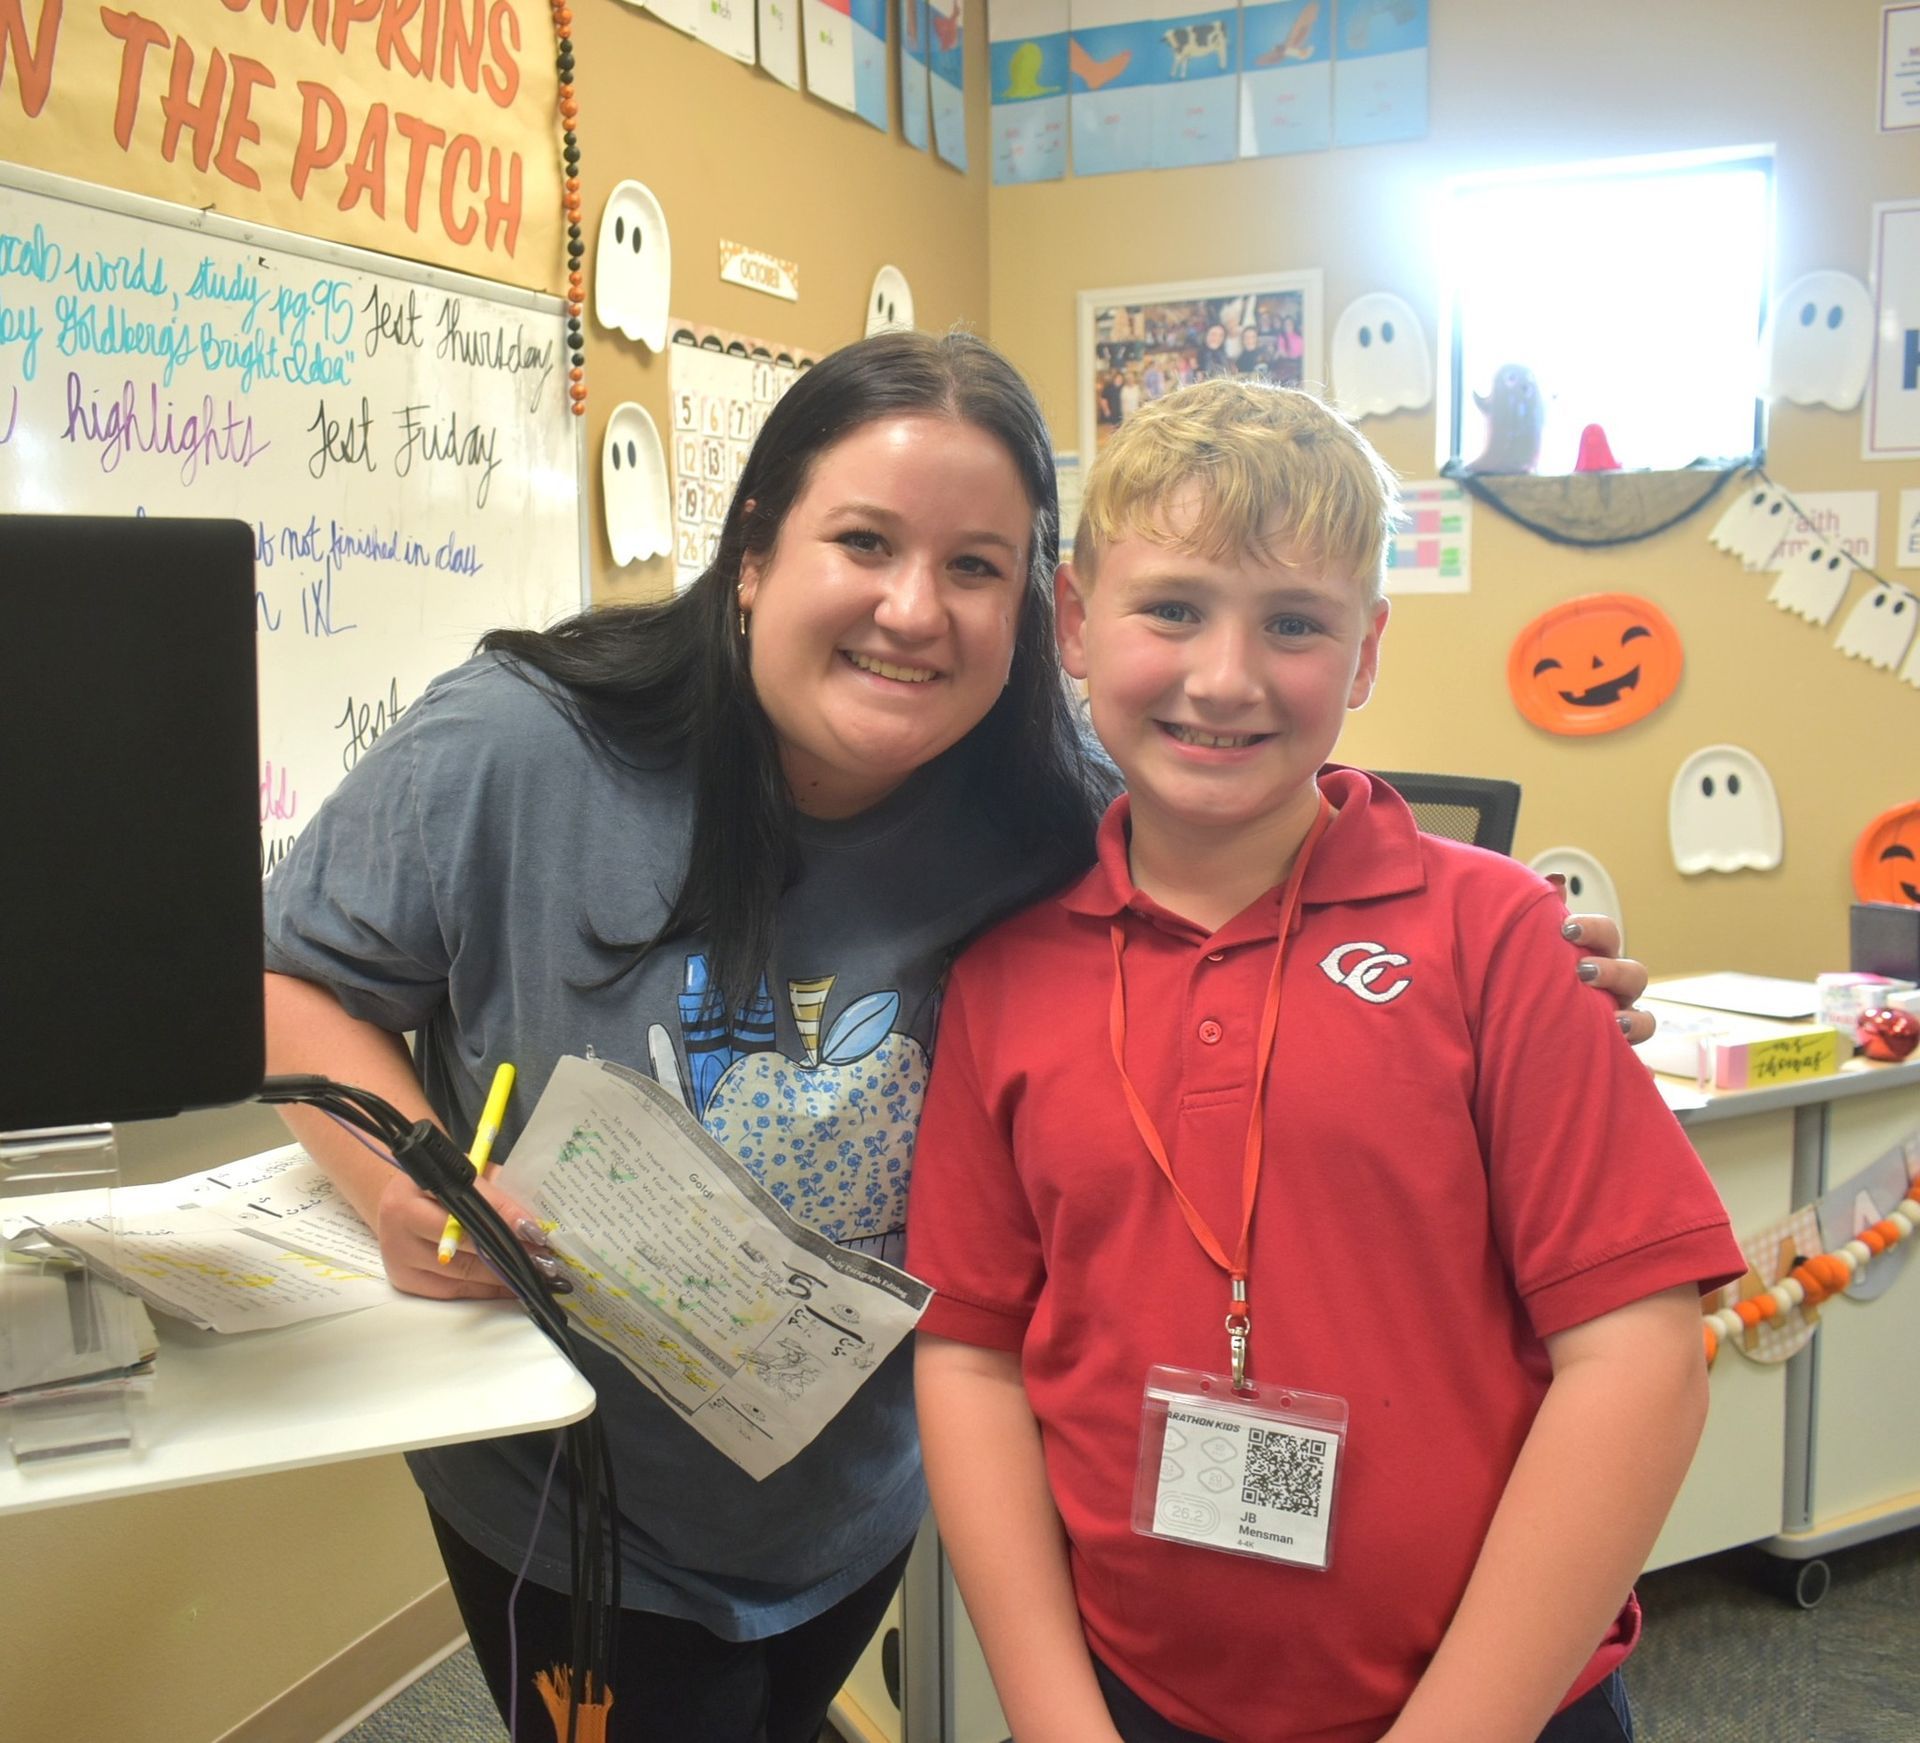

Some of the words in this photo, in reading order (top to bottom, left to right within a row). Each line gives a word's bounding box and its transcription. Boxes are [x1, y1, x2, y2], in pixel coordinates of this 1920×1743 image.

[218, 0, 521, 108] PKINS
[100, 10, 275, 191] THE
[290, 80, 523, 258] PATCH
[186, 256, 270, 333] study
[362, 283, 424, 358] Test
[437, 297, 554, 414] Thursday
[62, 371, 271, 487] highlights
[682, 395, 692, 426] 5
[709, 402, 719, 432] 6
[736, 407, 745, 435] 7
[307, 396, 377, 479] Test
[392, 404, 503, 509] Friday
[708, 446, 720, 476] 13
[685, 487, 698, 518] 19
[707, 486, 724, 519] 20
[281, 515, 323, 562] not
[329, 520, 401, 570] finished
[404, 536, 430, 566] in
[435, 530, 484, 576] class
[681, 530, 698, 561] 26
[1317, 941, 1412, 1004] CC
[685, 1171, 717, 1201] Gold!
[825, 1253, 846, 1269] Daily
[846, 1264, 882, 1284] Paragraph
[881, 1280, 907, 1299] Editing
[1214, 1420, 1240, 1433] KIDS
[1171, 1505, 1204, 1523] 26.2
[1238, 1526, 1294, 1545] Mensman
[1240, 1511, 1257, 1524] JB
